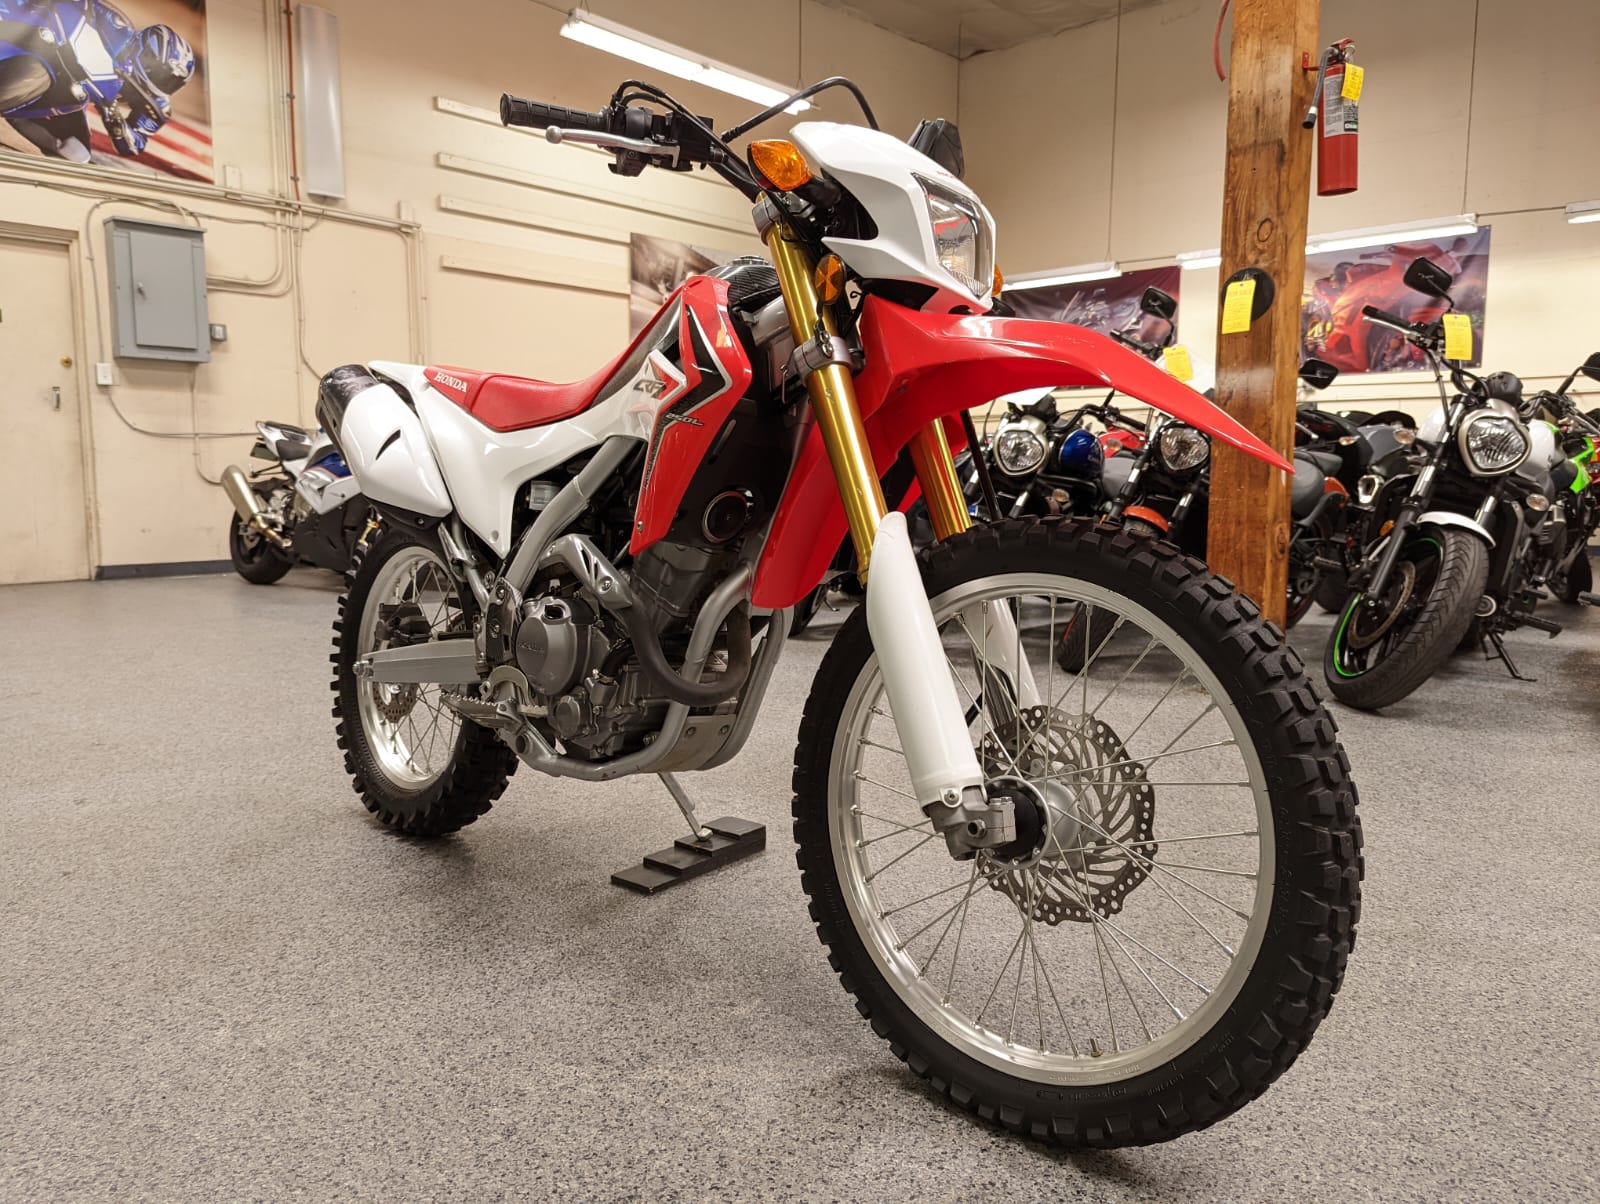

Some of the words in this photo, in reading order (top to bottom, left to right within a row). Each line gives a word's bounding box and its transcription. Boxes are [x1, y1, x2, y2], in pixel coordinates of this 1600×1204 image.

[434, 372, 468, 392] HONDA
[633, 379, 668, 399] CRF
[664, 412, 705, 427] 250L
